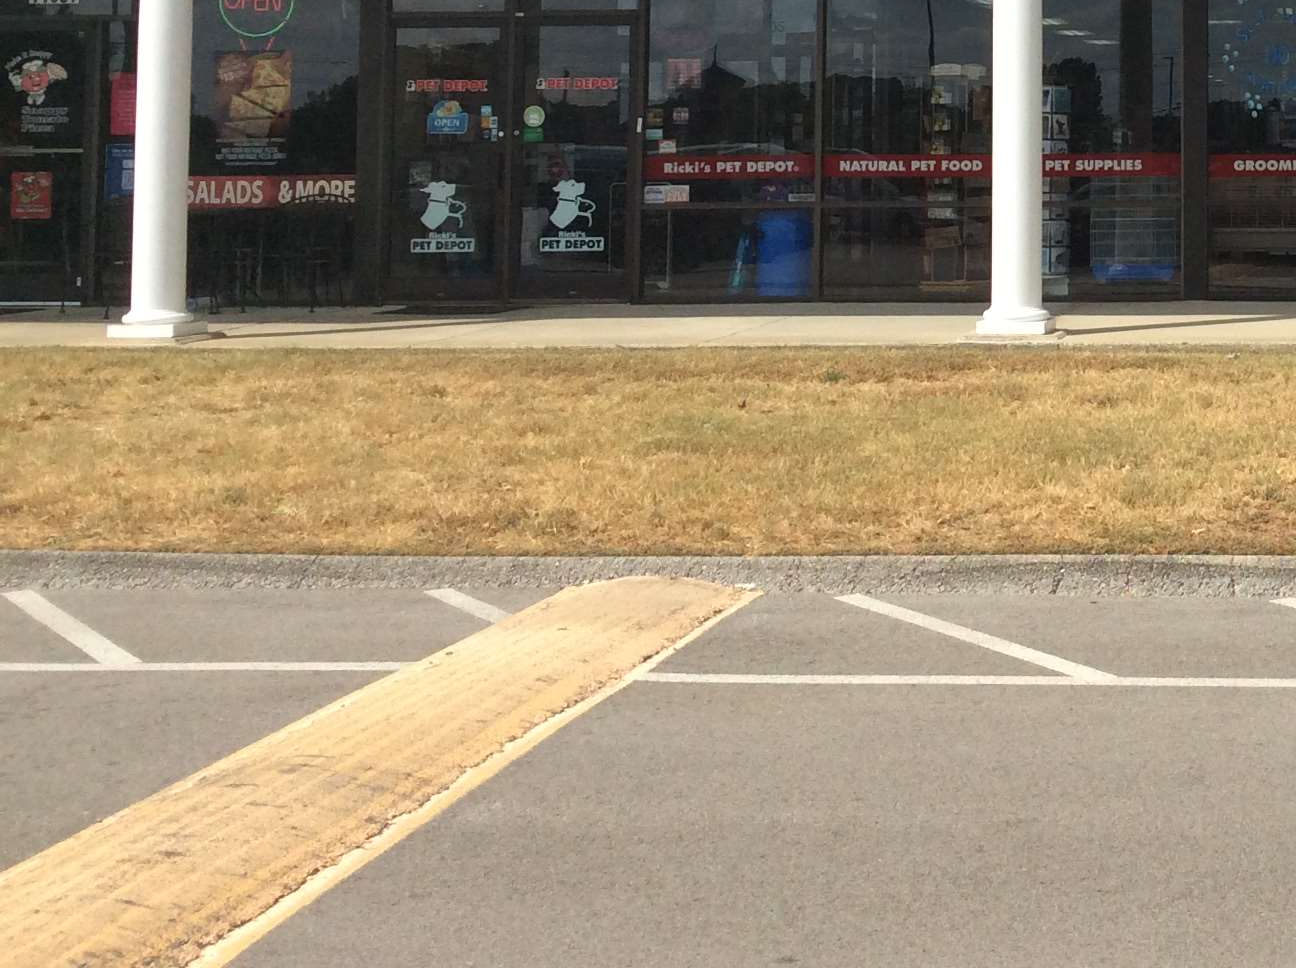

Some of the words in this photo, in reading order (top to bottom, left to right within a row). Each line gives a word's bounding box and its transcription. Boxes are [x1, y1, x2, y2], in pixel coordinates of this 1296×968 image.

[416, 79, 440, 93] PET
[443, 79, 488, 93] DEPOT
[545, 77, 571, 90] PET
[575, 77, 618, 90] DEPOT
[434, 118, 460, 128] OPEN
[663, 162, 711, 174] Ricki's
[716, 161, 742, 173] PET
[746, 161, 794, 173] DEPOT
[839, 160, 906, 172] NATURAL
[911, 160, 936, 172] PET
[941, 159, 983, 172] FOOD
[1045, 160, 1071, 171] PET
[1075, 159, 1142, 171] SUPPLIES
[412, 241, 431, 251] PET
[436, 241, 472, 251] DEPOT
[541, 240, 561, 250] PET
[565, 240, 602, 250] DEPOT
